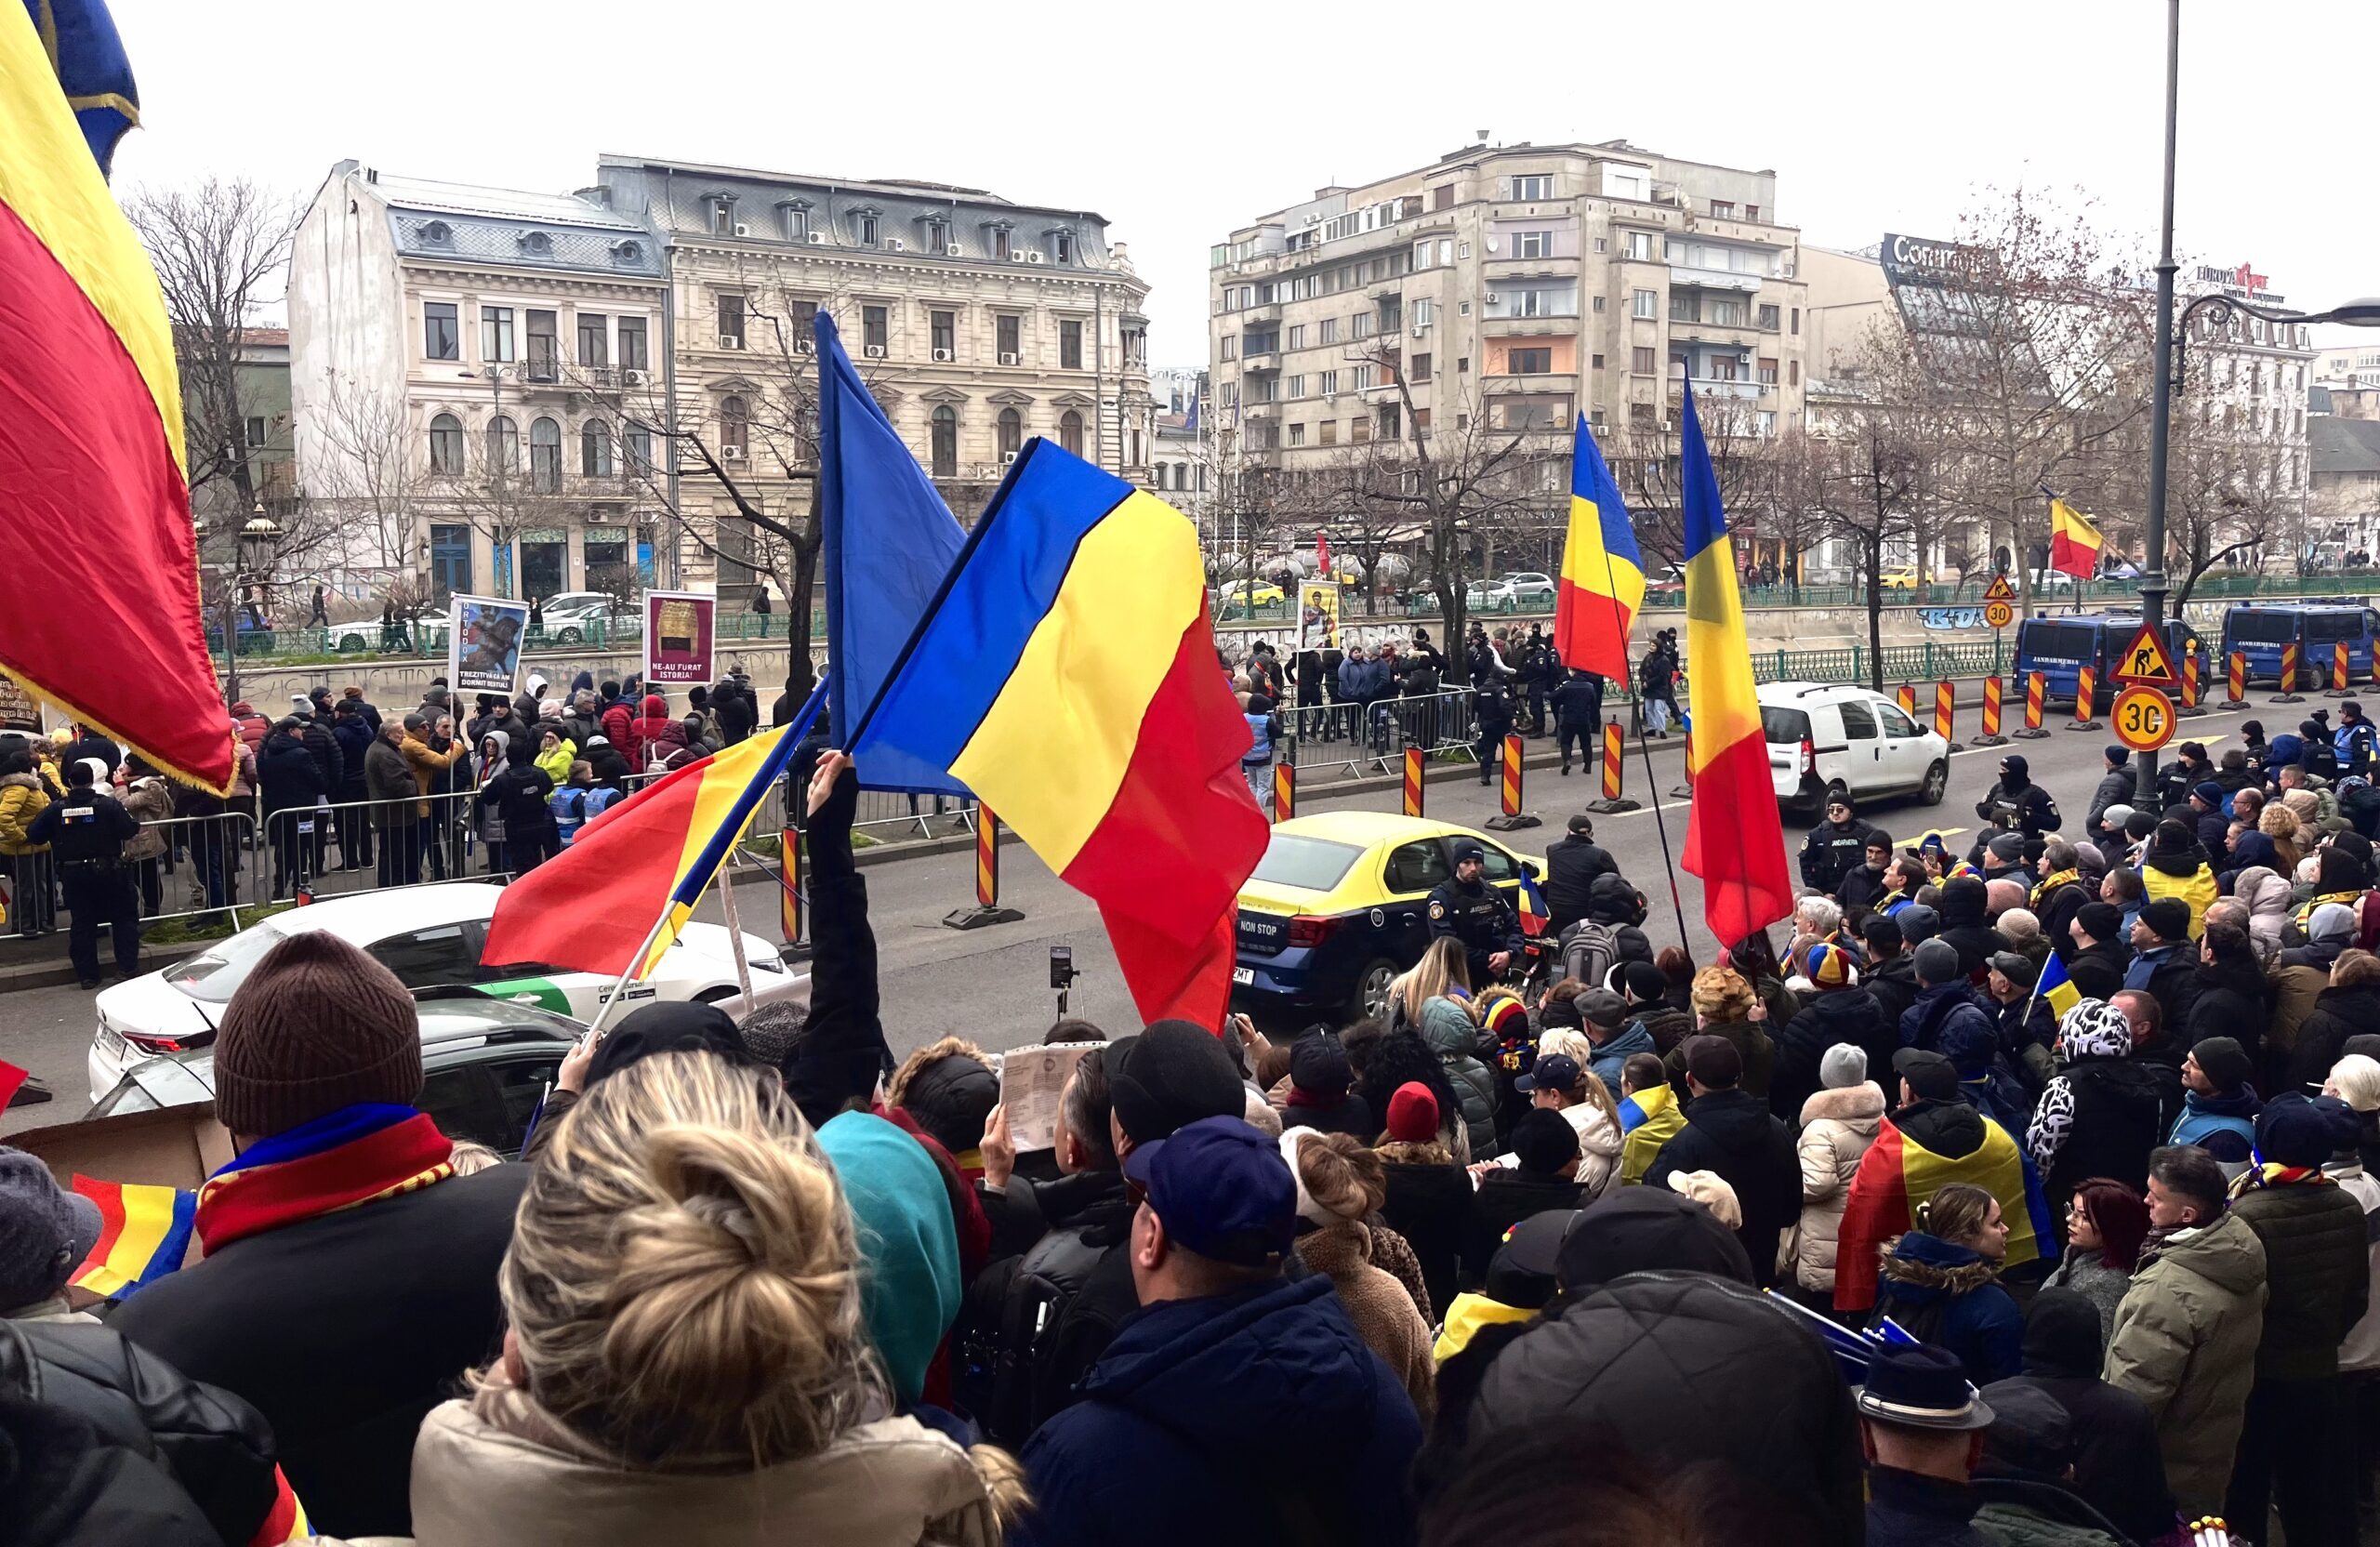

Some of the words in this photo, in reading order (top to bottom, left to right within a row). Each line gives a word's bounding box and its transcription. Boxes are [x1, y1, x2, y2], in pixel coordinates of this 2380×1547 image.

[1990, 607, 2006, 621] 30
[462, 602, 470, 663] ORTODOX
[652, 662, 676, 670] NE-AU
[677, 663, 702, 671] FURAT
[660, 670, 693, 679] ISTORIA!
[2125, 703, 2160, 734] 30
[1240, 920, 1256, 933] NON
[1257, 923, 1277, 936] STOP
